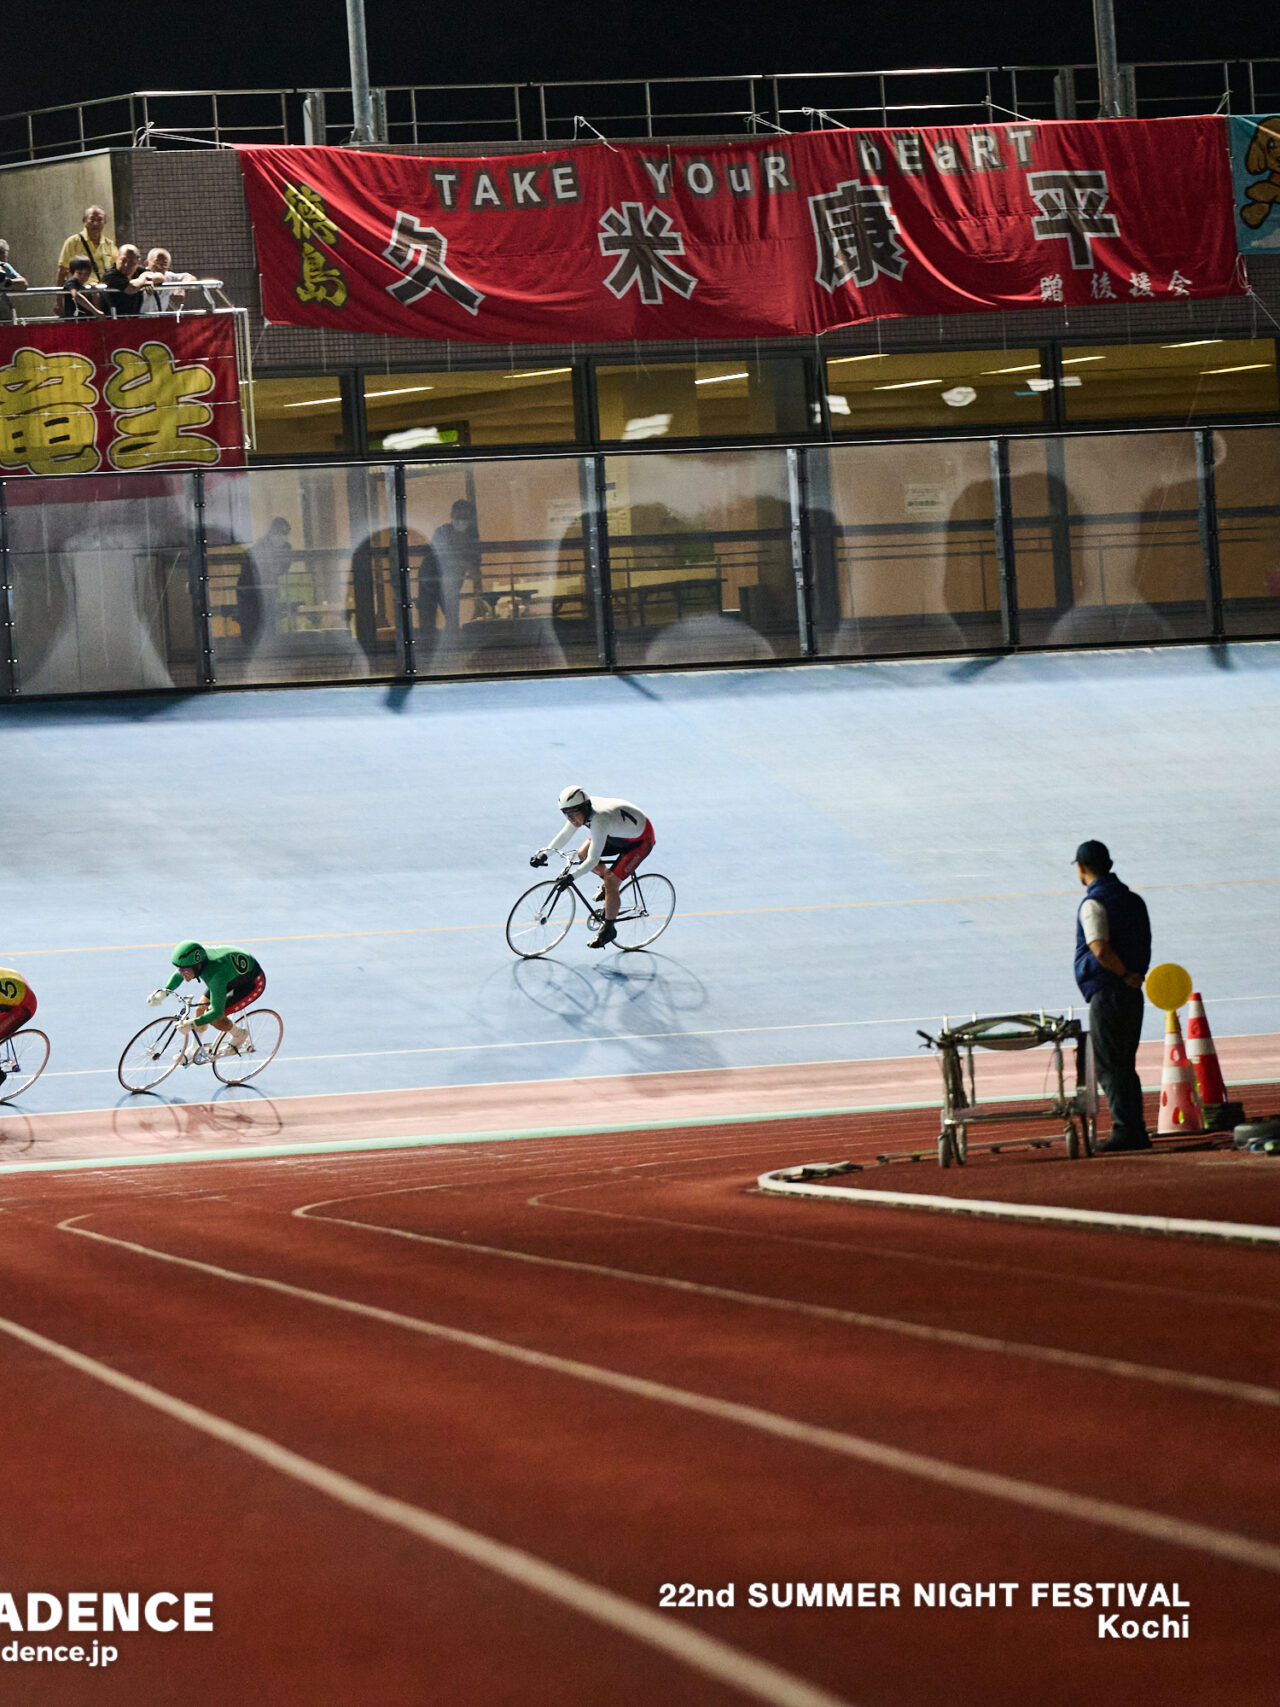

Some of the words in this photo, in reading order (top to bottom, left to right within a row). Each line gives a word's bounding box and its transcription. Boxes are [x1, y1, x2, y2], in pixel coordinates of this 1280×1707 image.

[434, 166, 578, 207] TAKE
[282, 180, 349, 308] 徳島
[382, 169, 1121, 316] 久米康平
[1090, 269, 1193, 299] 後援会
[229, 952, 250, 975] 6
